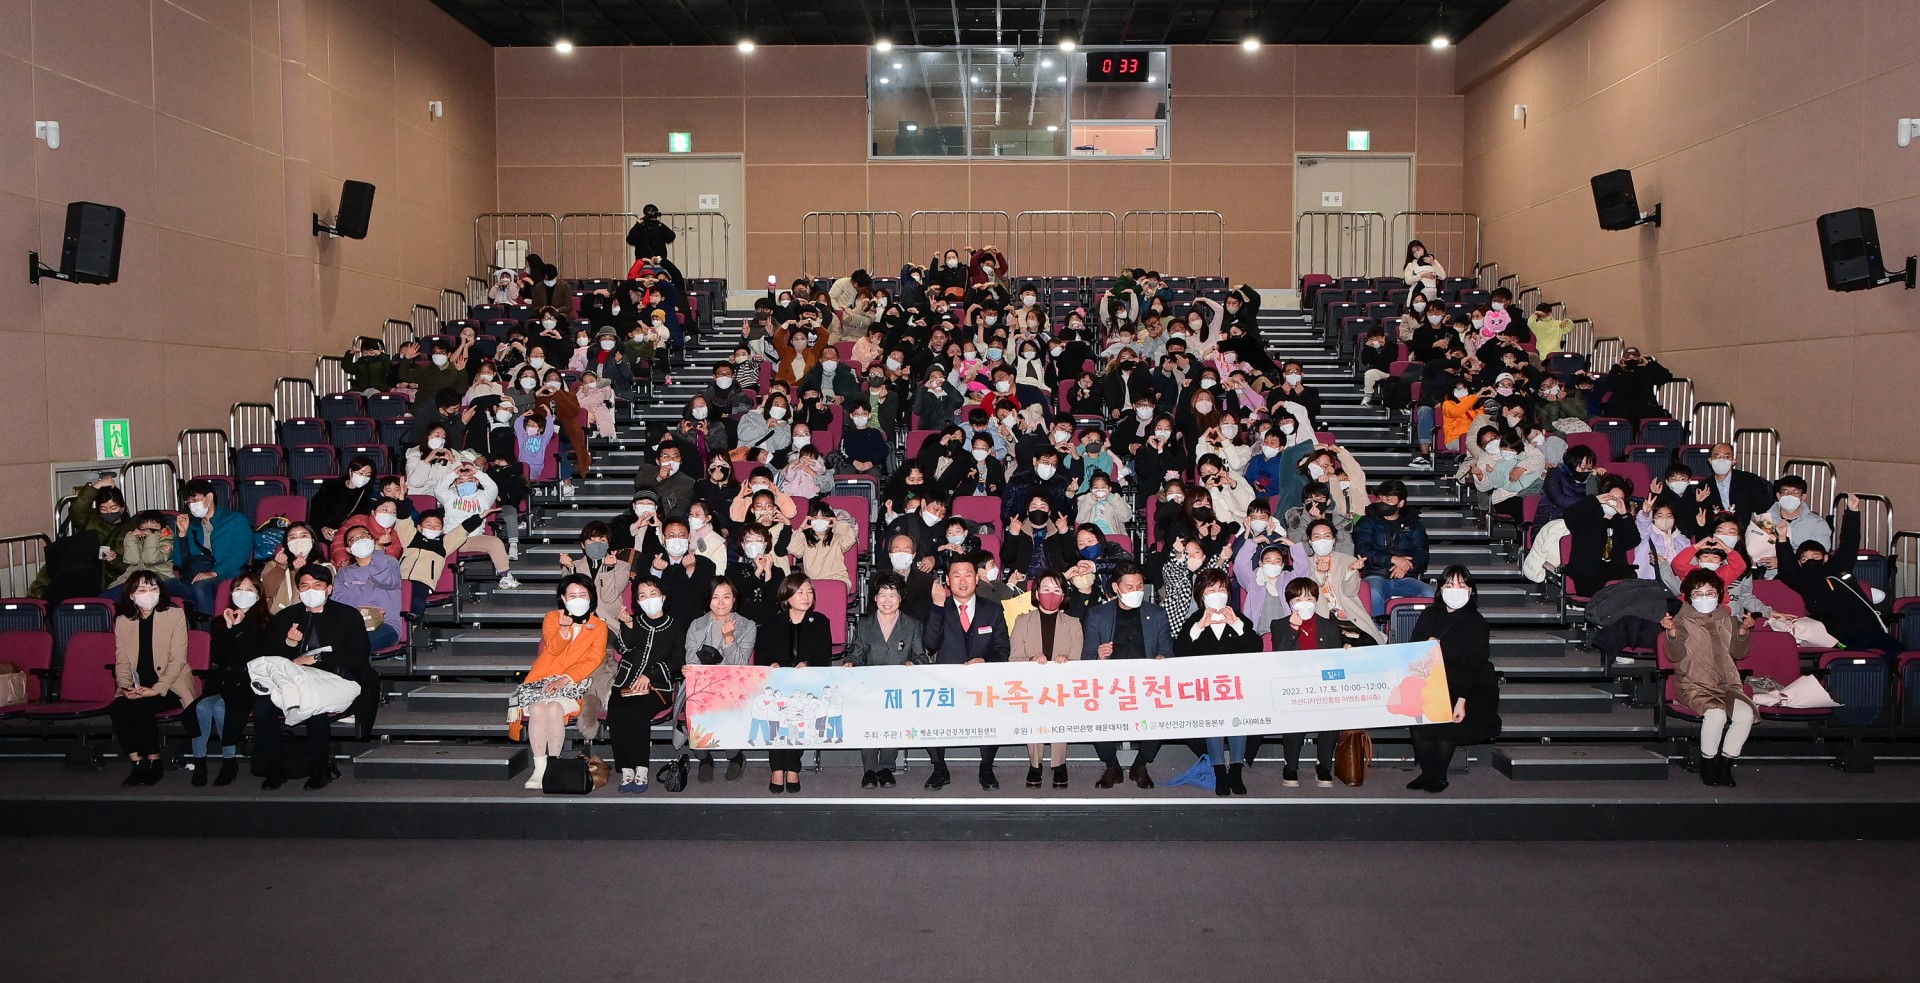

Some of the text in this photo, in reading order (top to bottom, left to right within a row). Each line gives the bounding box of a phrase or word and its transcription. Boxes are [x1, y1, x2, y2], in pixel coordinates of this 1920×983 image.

[1102, 59, 1138, 73] 0 33
[1282, 687, 1303, 696] 2022.
[884, 688, 903, 710] 제
[911, 687, 956, 709] 17회
[1242, 716, 1272, 726] (사)미소원
[919, 727, 997, 737] 해운대구건강가정지원센터
[1013, 727, 1028, 736] 후원
[1095, 723, 1130, 732] 해운대지점
